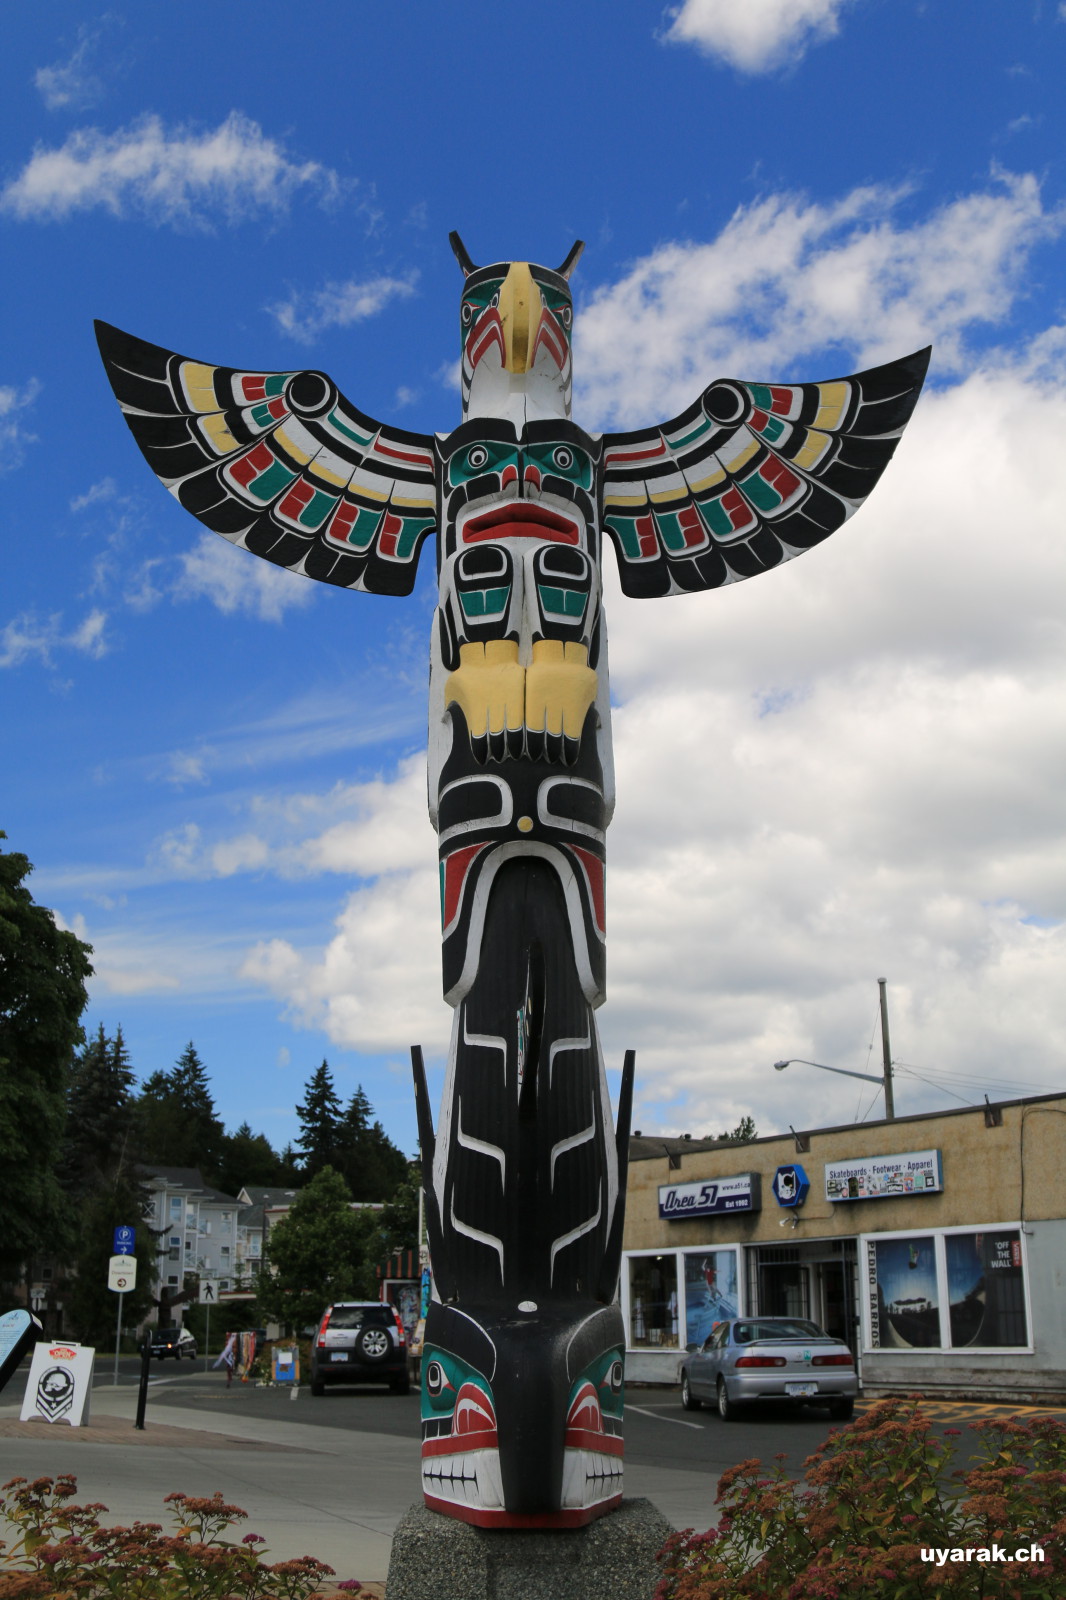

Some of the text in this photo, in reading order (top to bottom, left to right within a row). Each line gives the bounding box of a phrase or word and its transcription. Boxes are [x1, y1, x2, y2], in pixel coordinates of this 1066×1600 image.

[830, 1159, 933, 1179] Skateboards Footwear Apparel
[663, 1184, 719, 1212] Area 51
[122, 1230, 129, 1239] P
[868, 1241, 877, 1285] PEDRO
[997, 1250, 1011, 1259] THE
[870, 1293, 880, 1348] BARROS
